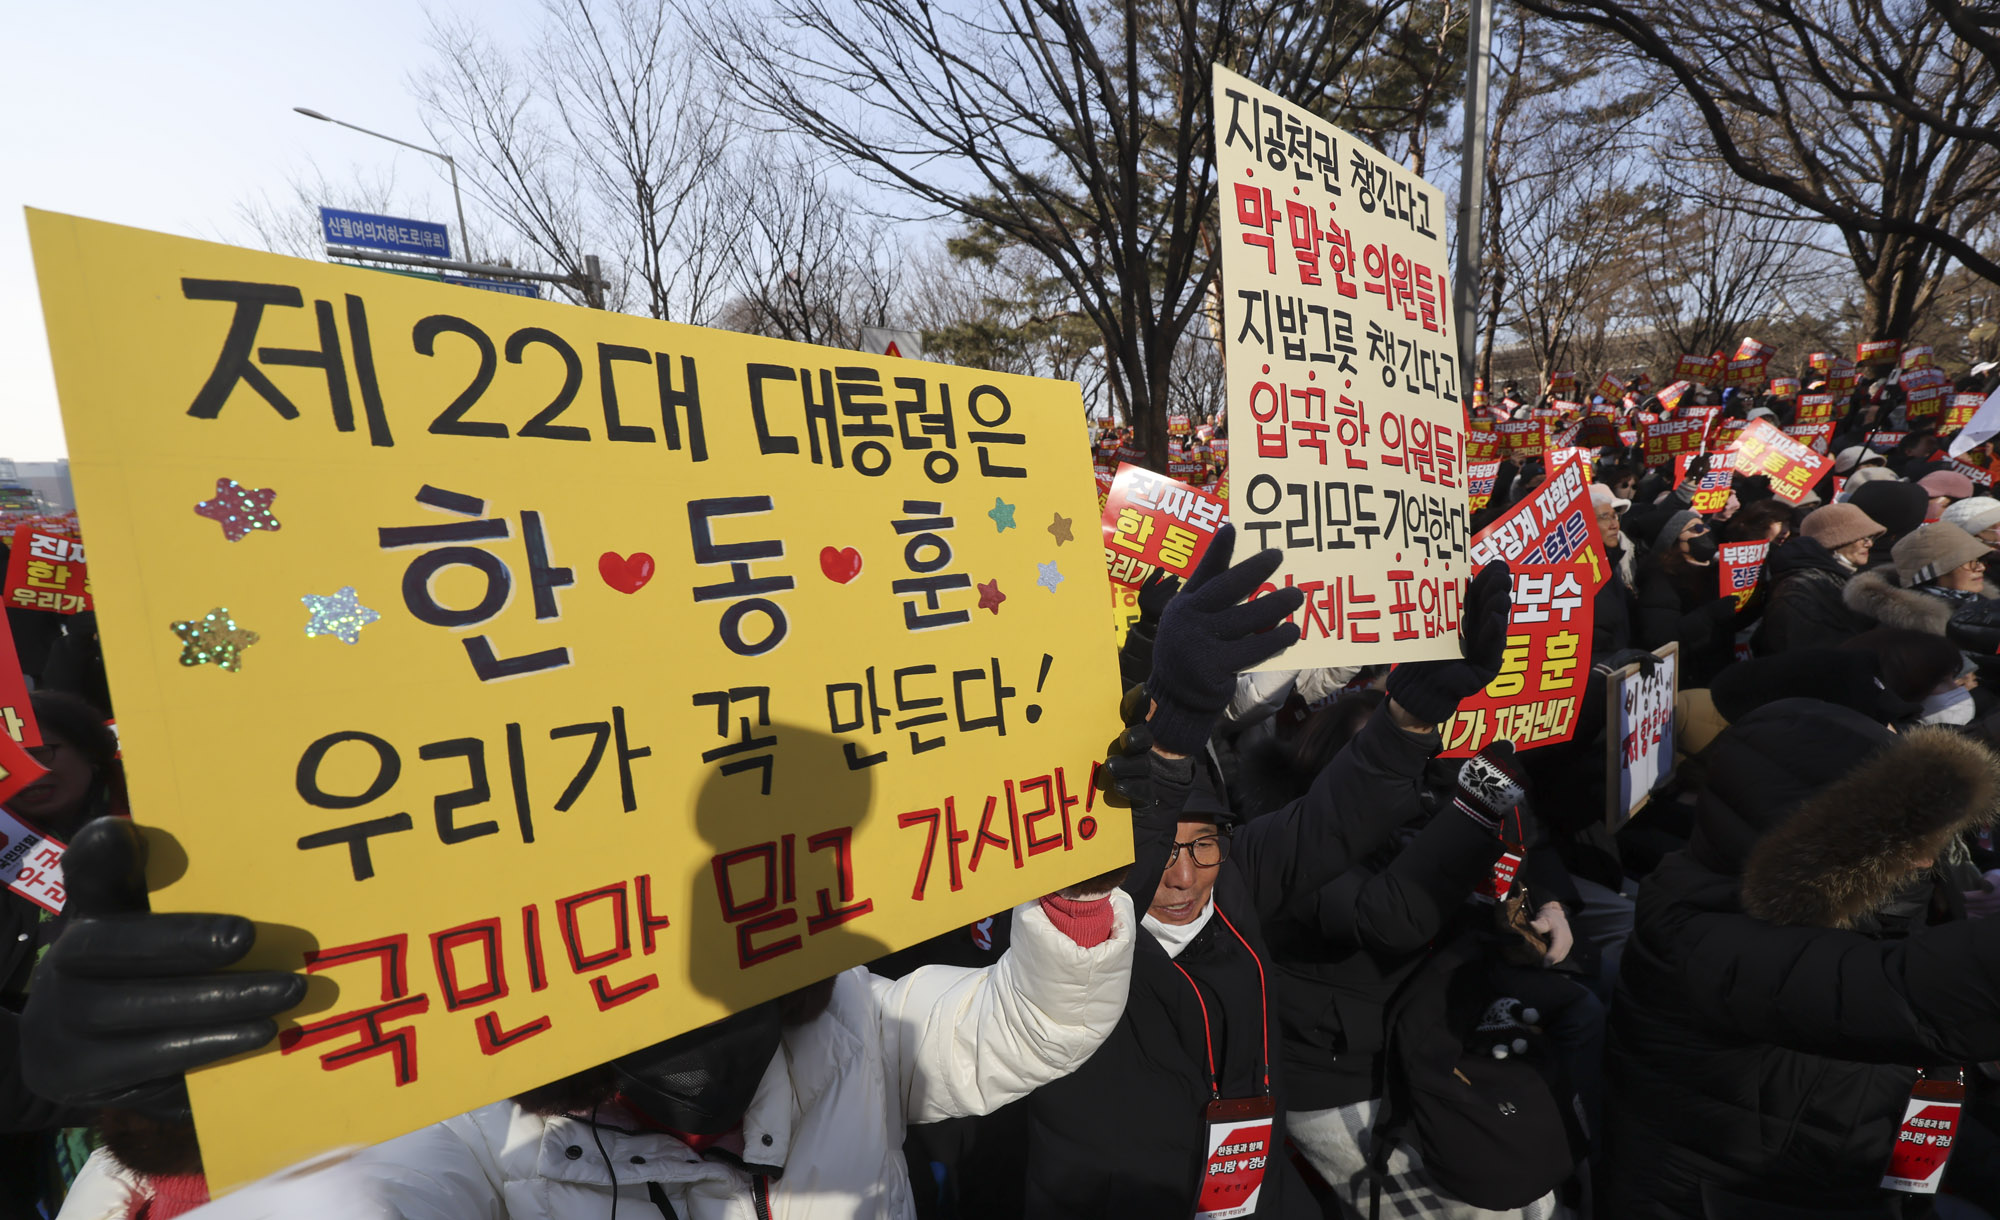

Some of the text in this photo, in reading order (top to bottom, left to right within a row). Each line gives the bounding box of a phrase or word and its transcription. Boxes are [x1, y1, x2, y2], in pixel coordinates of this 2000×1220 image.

[1224, 87, 1438, 241] 지공천권 챙긴다고
[326, 215, 446, 250] 신월여의지하도로(유료)
[1237, 289, 1458, 403] 지밥그릇 챙긴다고
[746, 362, 1028, 484] 대통령은
[1379, 410, 1464, 488] 의원들!
[1125, 471, 1230, 534] 진짜보
[1534, 460, 1585, 524] 자행한
[11, 587, 87, 614] 우리가
[295, 653, 1054, 881] 우리가 꼭 만든다!
[279, 760, 1105, 1087] 국민만 믿고 가시라!
[1208, 1155, 1268, 1176] 후니랑 경남
